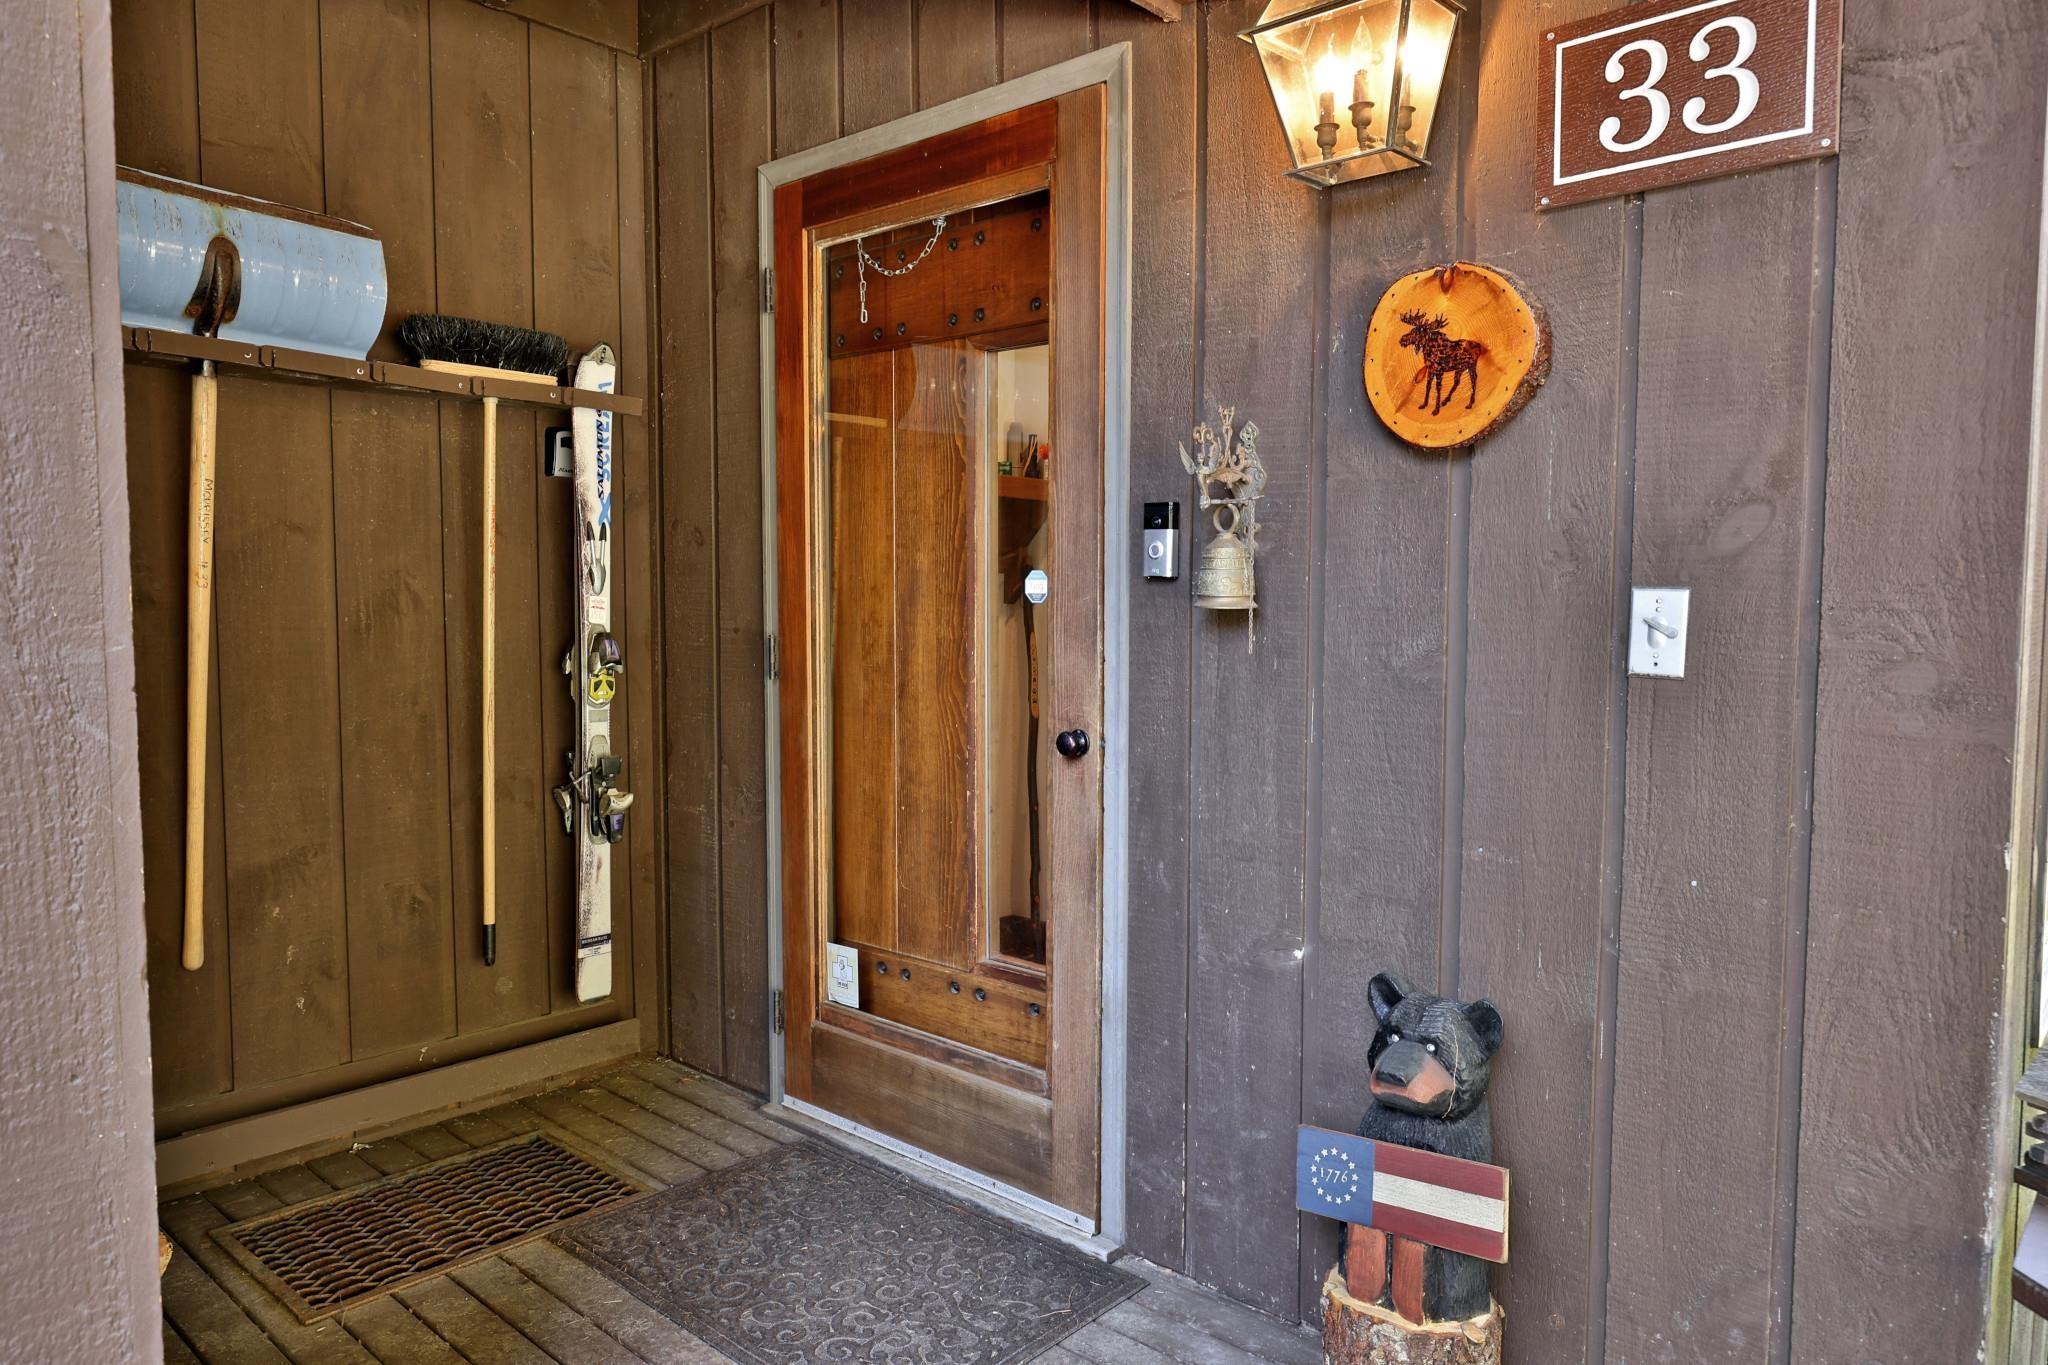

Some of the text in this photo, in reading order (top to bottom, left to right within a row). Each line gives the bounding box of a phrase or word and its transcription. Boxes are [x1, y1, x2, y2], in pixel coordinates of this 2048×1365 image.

[1599, 15, 1760, 153] 33
[596, 419, 605, 499] SALOMON
[1320, 1167, 1348, 1184] 1776
